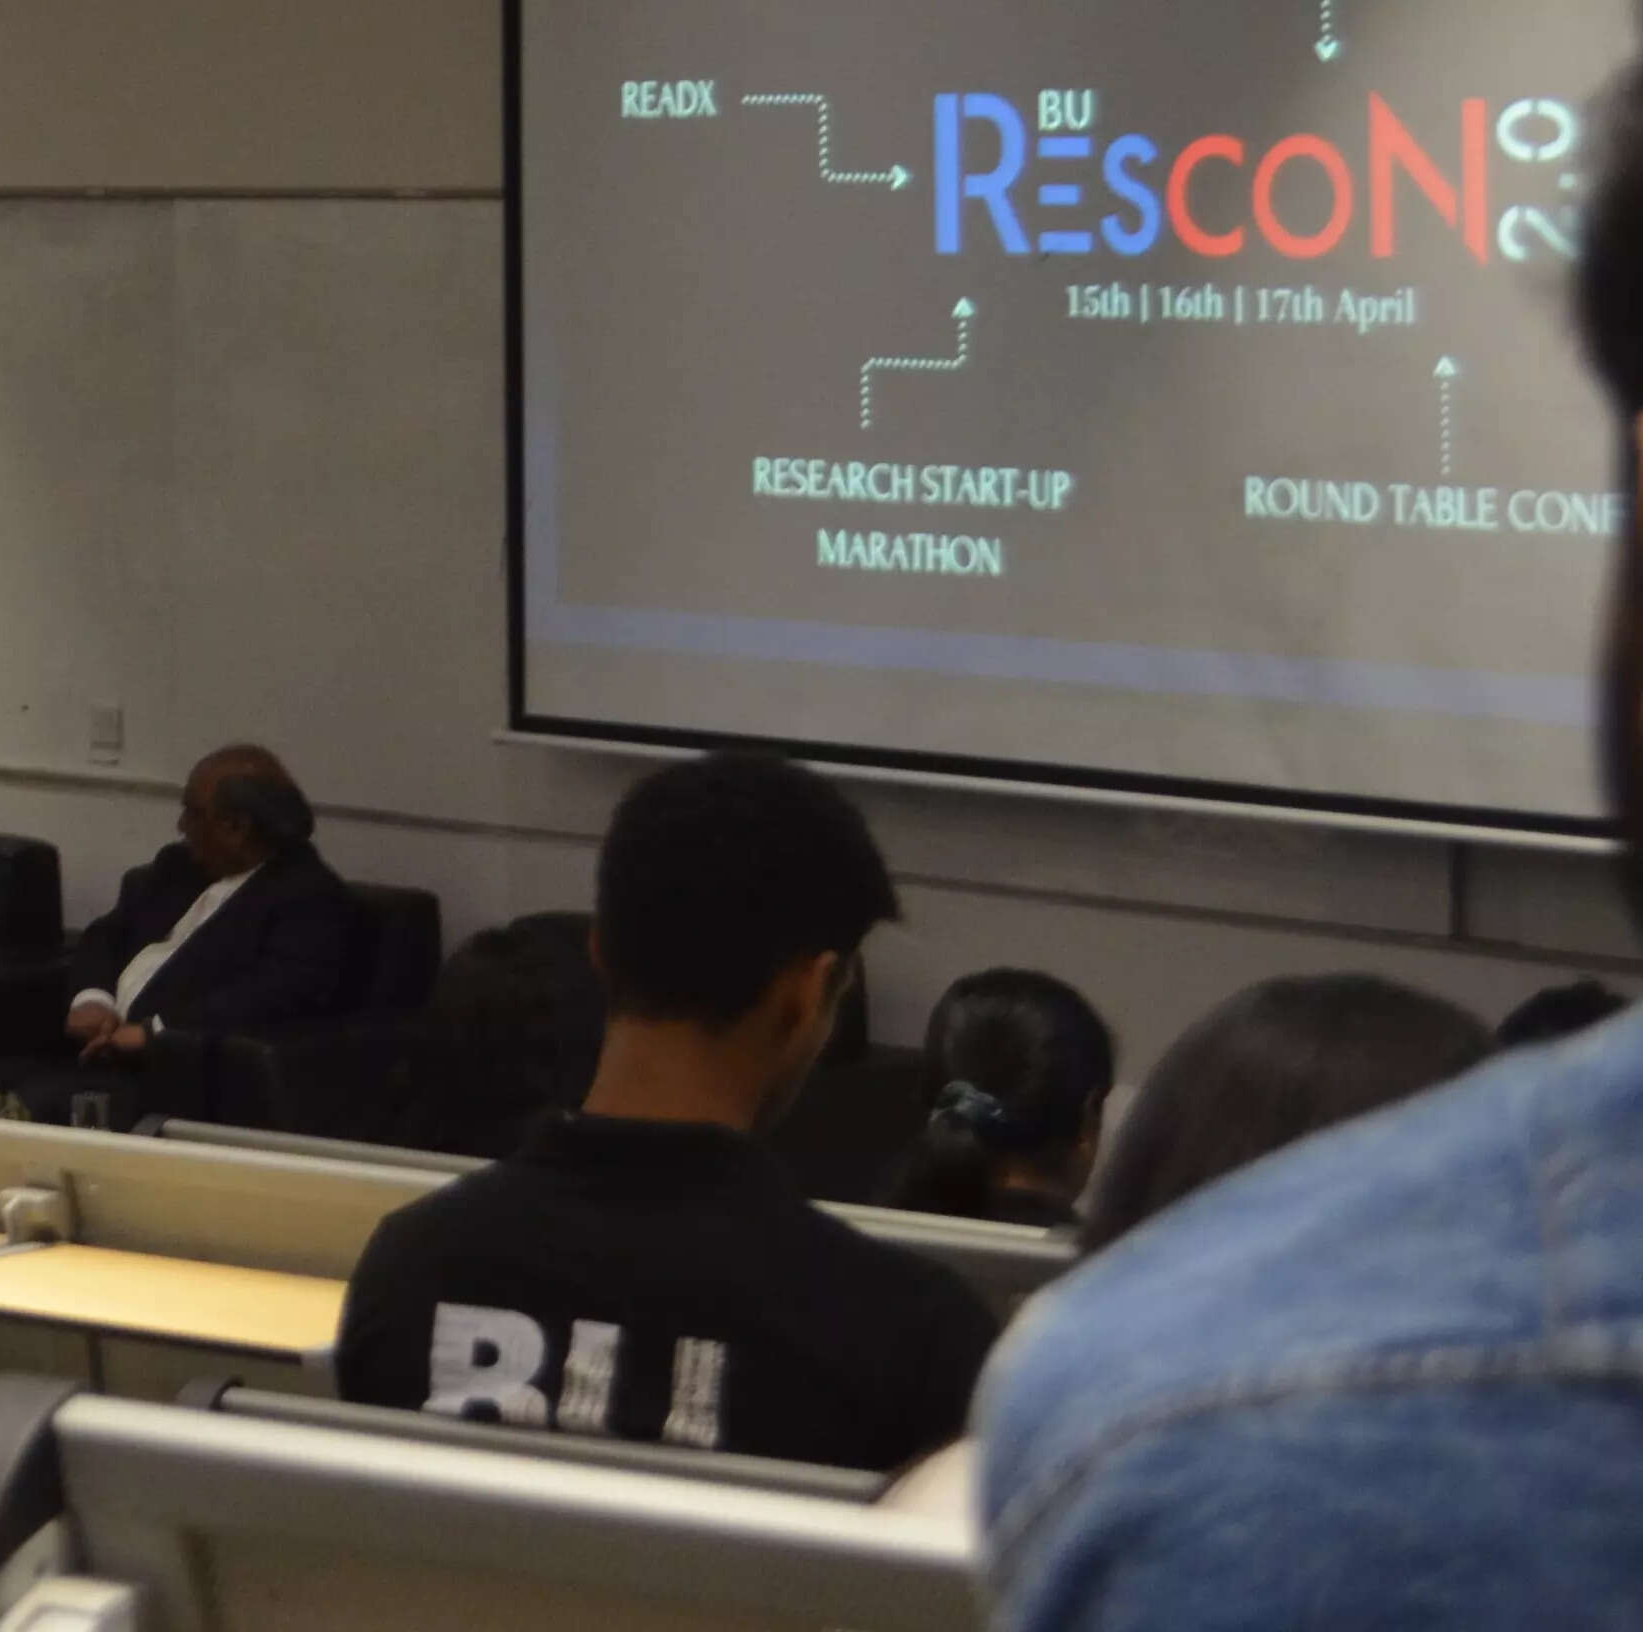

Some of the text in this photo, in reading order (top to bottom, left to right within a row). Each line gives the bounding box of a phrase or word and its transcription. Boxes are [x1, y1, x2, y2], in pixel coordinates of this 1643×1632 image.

[621, 80, 717, 118] READX
[1038, 88, 1094, 131] BU
[1066, 282, 1131, 320] 15th
[1159, 282, 1223, 322] 16th
[1257, 283, 1324, 323] 17th
[1334, 286, 1418, 334] April
[753, 456, 1073, 511] RESEARCH START-UP
[1244, 475, 1380, 522] ROUND
[1388, 483, 1499, 530] TABLE
[817, 527, 1003, 577] MARATHON
